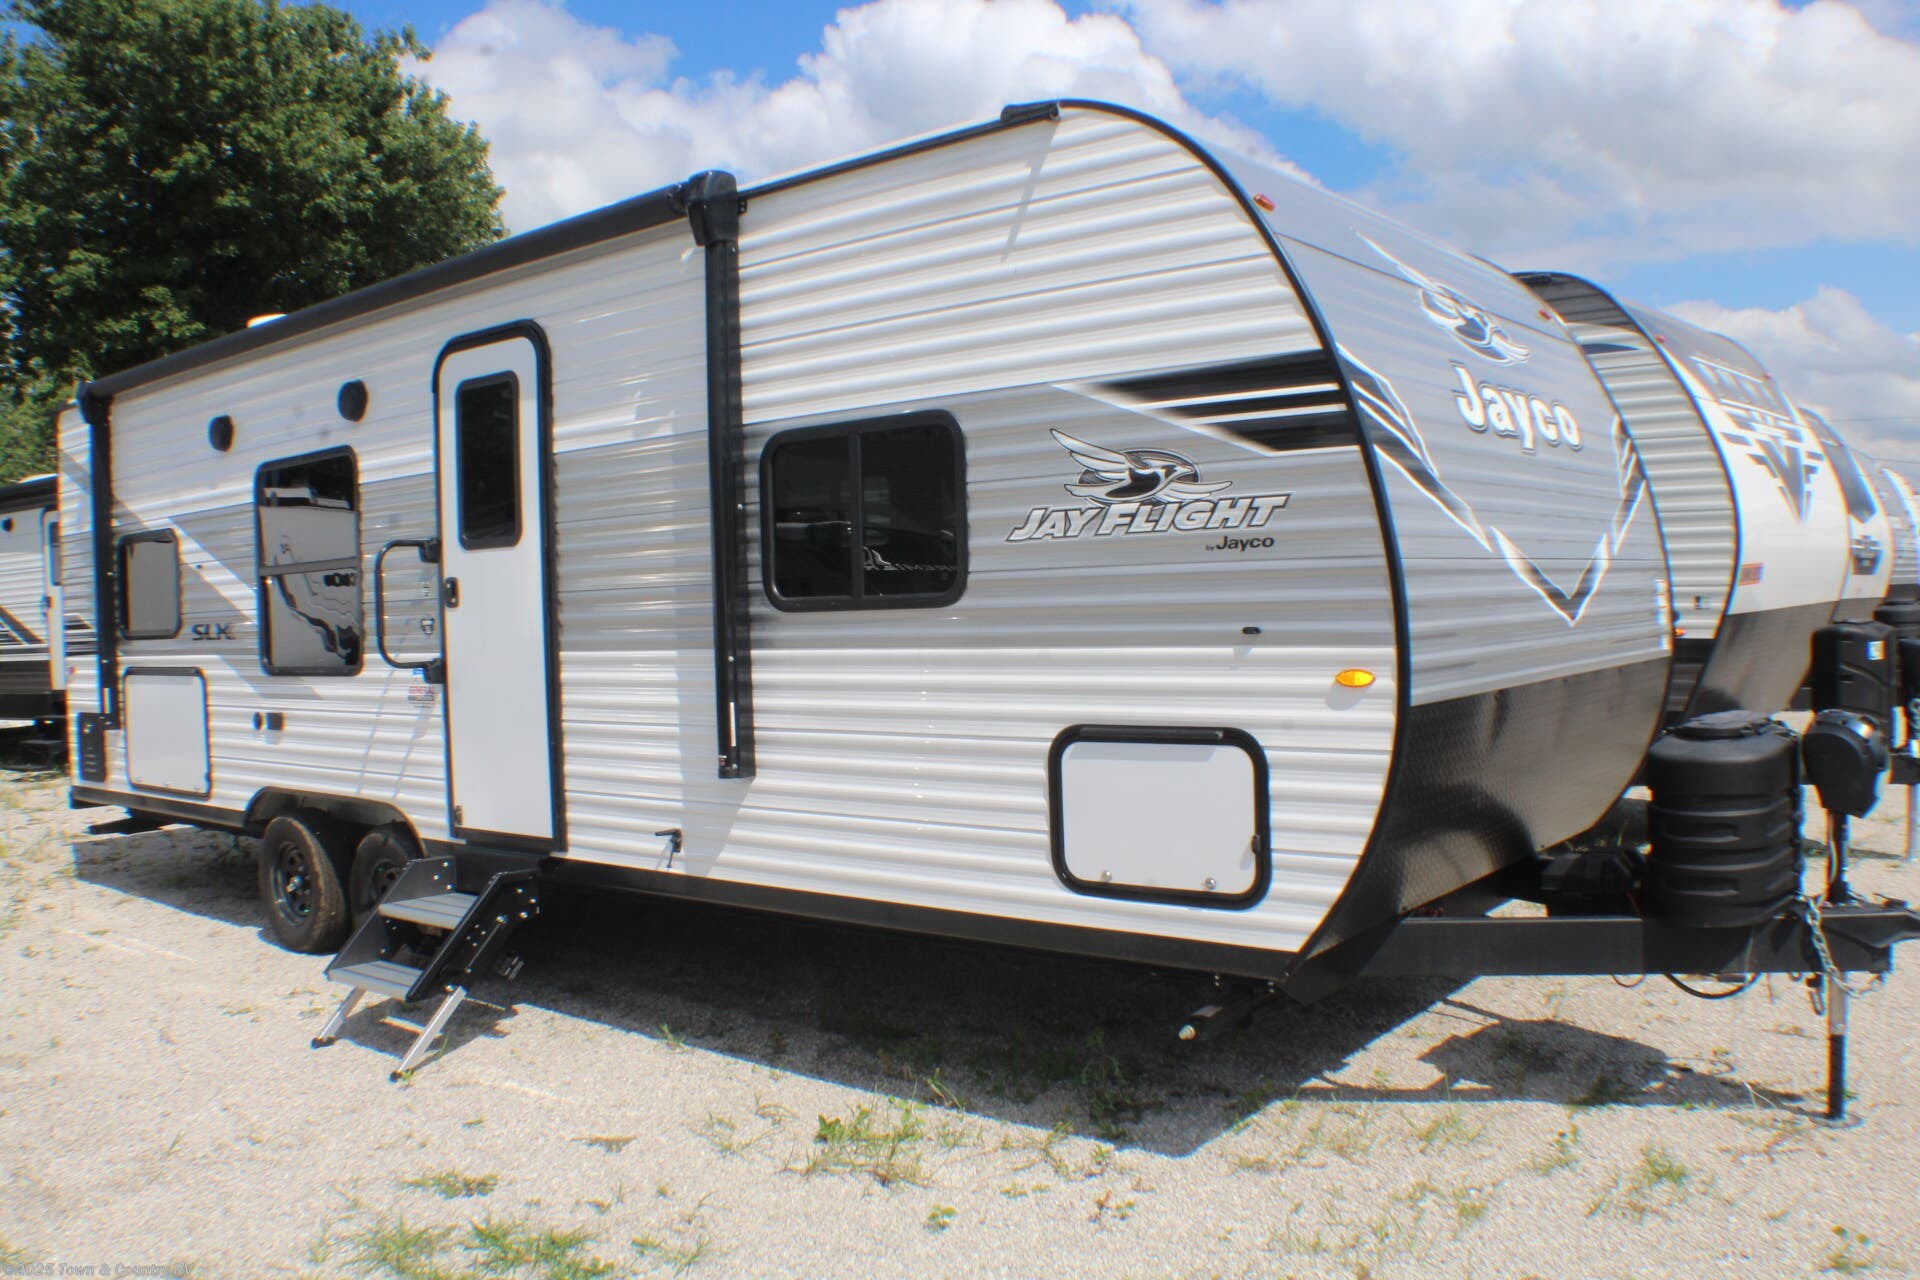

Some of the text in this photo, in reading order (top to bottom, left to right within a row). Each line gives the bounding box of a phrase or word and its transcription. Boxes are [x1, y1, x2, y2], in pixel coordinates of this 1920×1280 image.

[1451, 361, 1583, 453] Jayco
[1096, 493, 1292, 536] FLIGHT
[1216, 535, 1275, 552] Jayco
